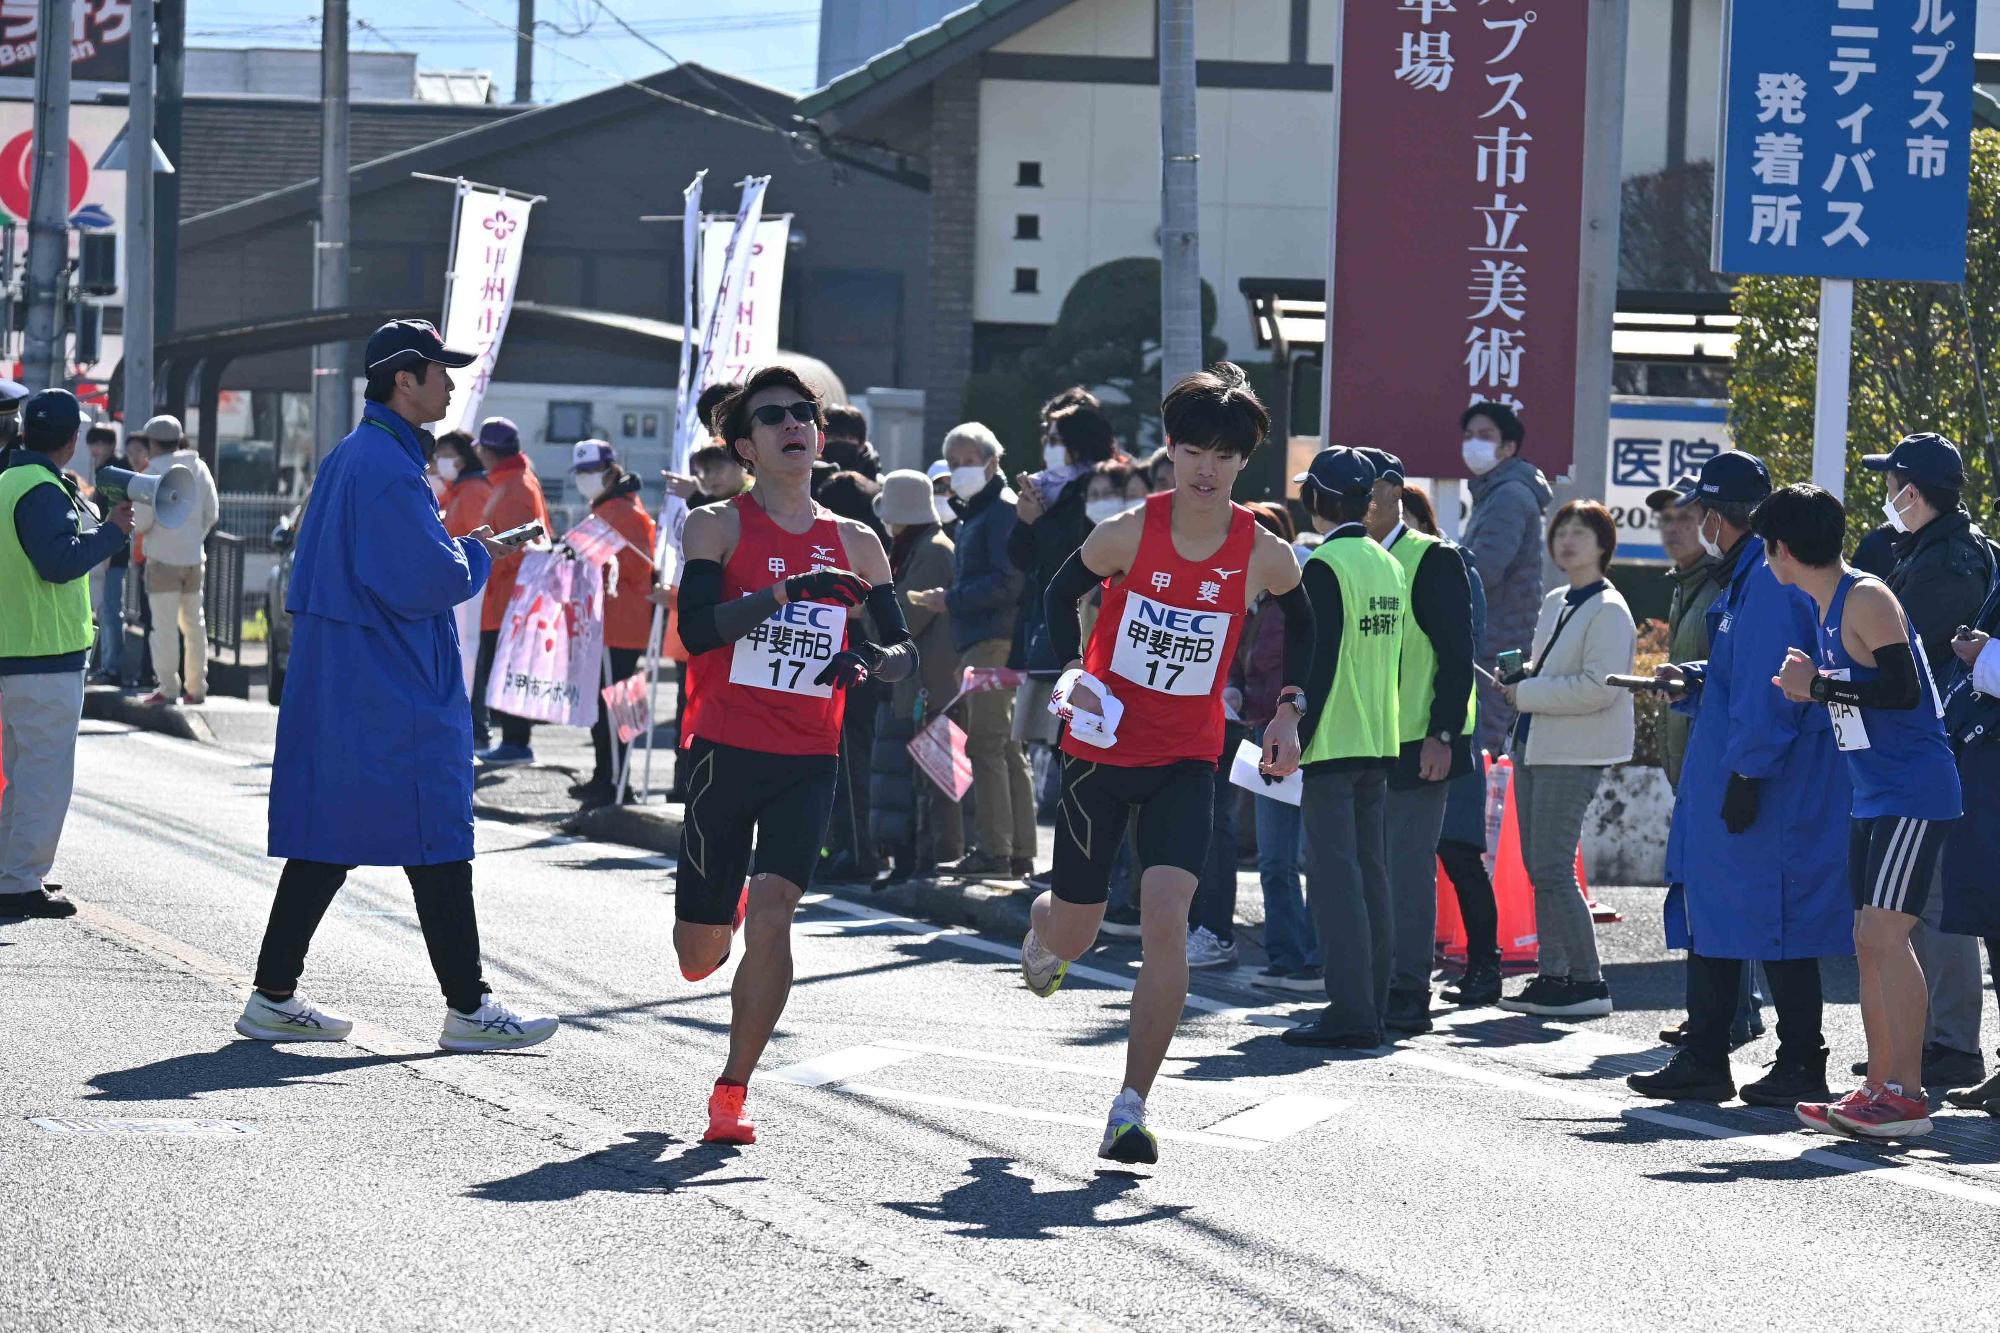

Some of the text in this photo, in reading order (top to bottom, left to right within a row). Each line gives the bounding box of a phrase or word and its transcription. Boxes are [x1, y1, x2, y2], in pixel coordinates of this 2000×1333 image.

[1748, 72, 1807, 246] 発着所
[1463, 0, 1537, 419] プス市立美術
[1612, 438, 1720, 487] 医院
[1138, 600, 1217, 634] NEC
[746, 624, 832, 661] 甲斐市B
[1128, 619, 1214, 663] 甲斐市B
[768, 658, 806, 689] 17
[1145, 660, 1184, 690] 17
